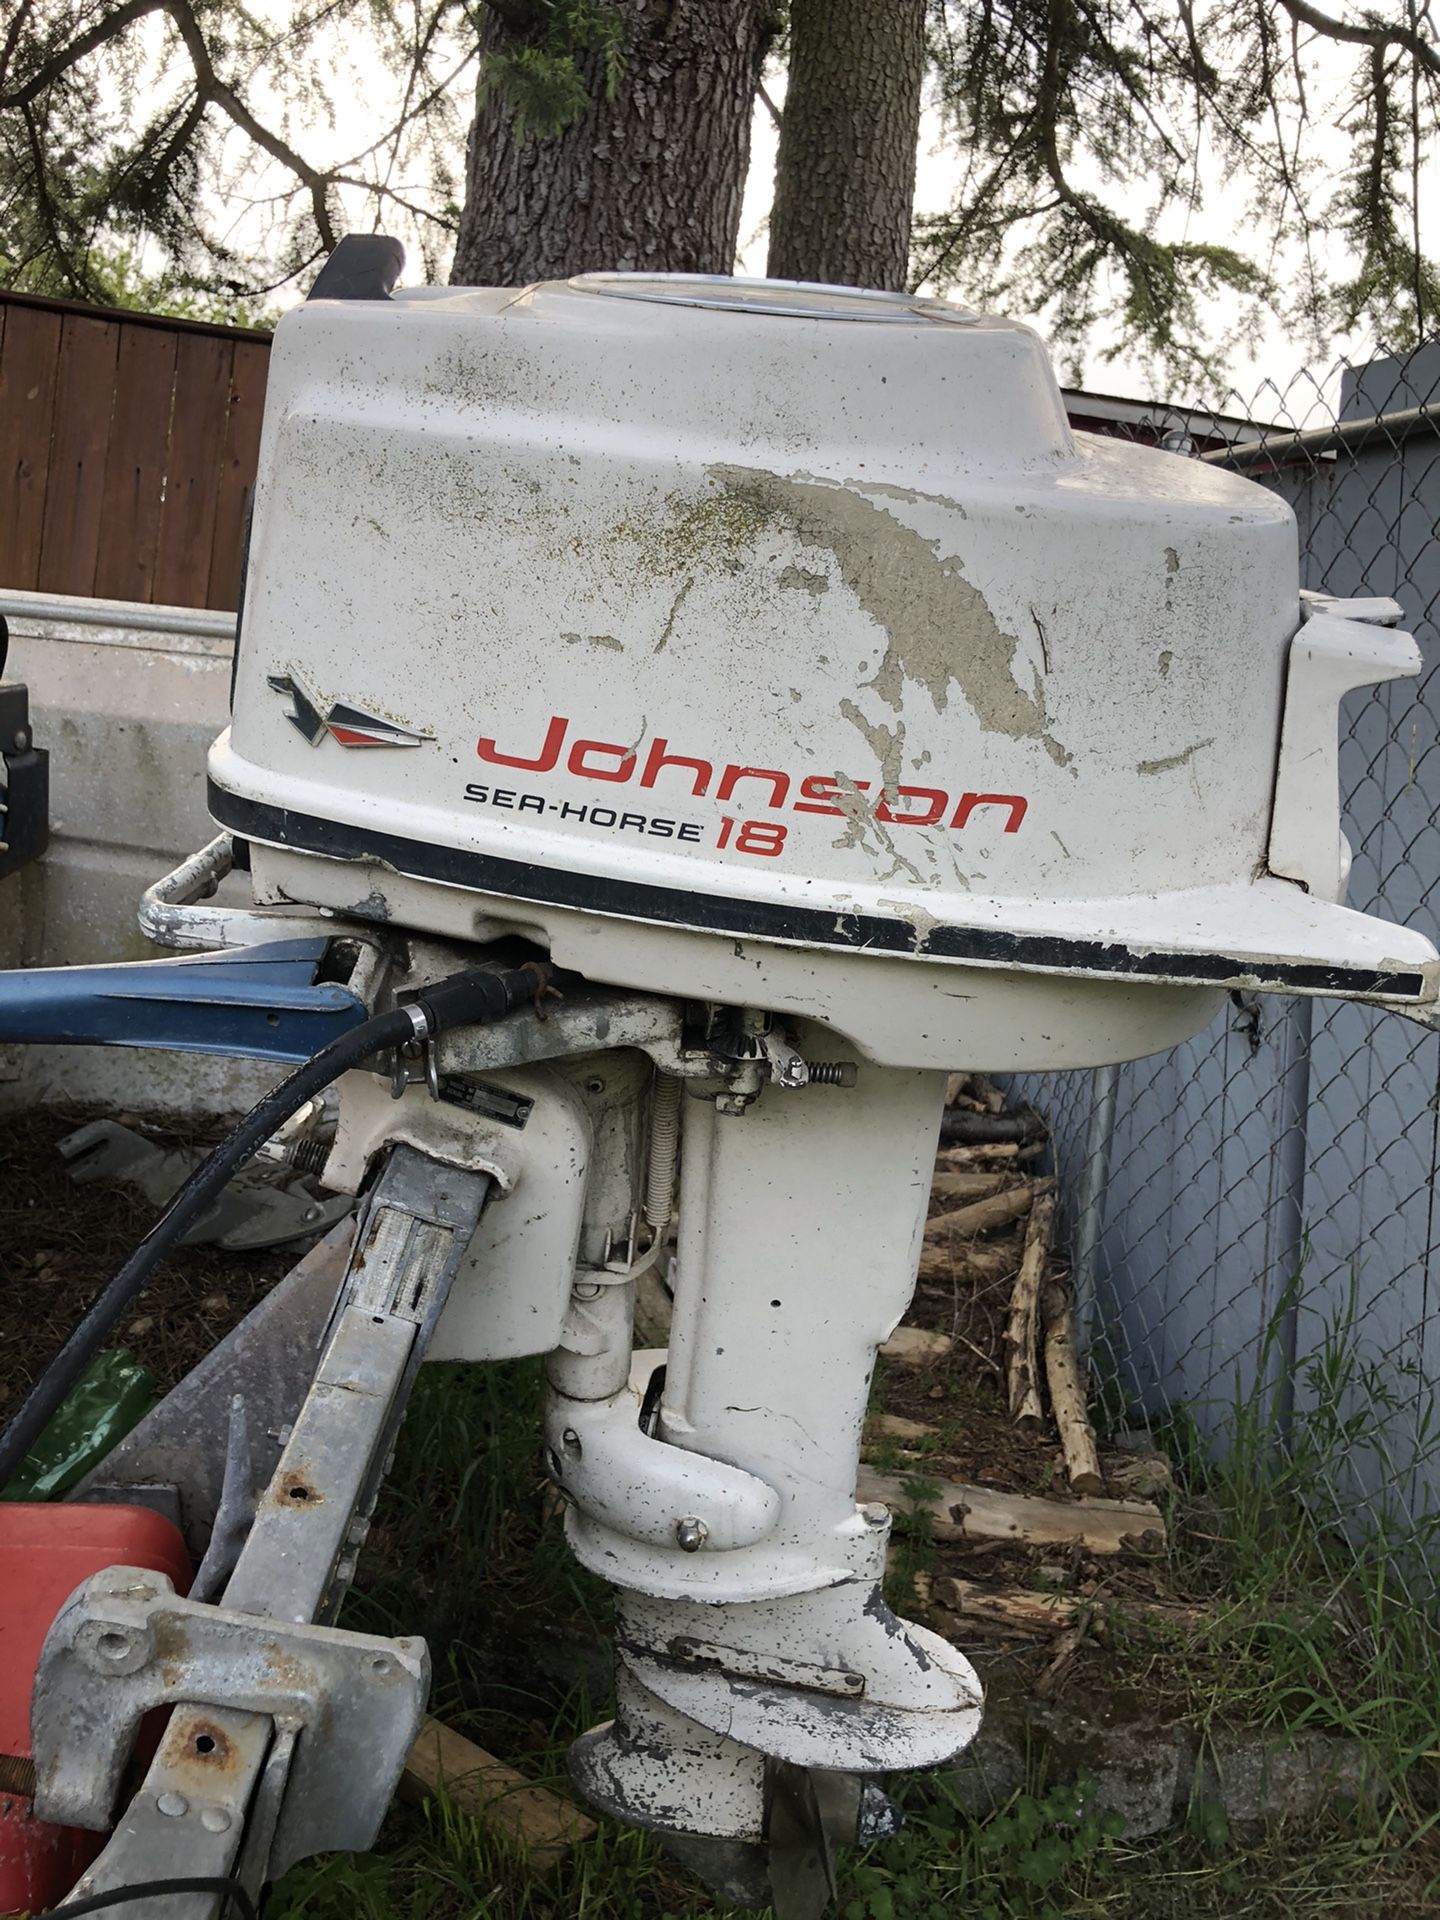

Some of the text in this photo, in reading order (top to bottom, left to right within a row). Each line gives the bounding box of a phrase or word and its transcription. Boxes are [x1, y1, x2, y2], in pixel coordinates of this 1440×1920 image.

[463, 783, 788, 857] SEA-HORSE 18
[477, 716, 1027, 833] Johnson
